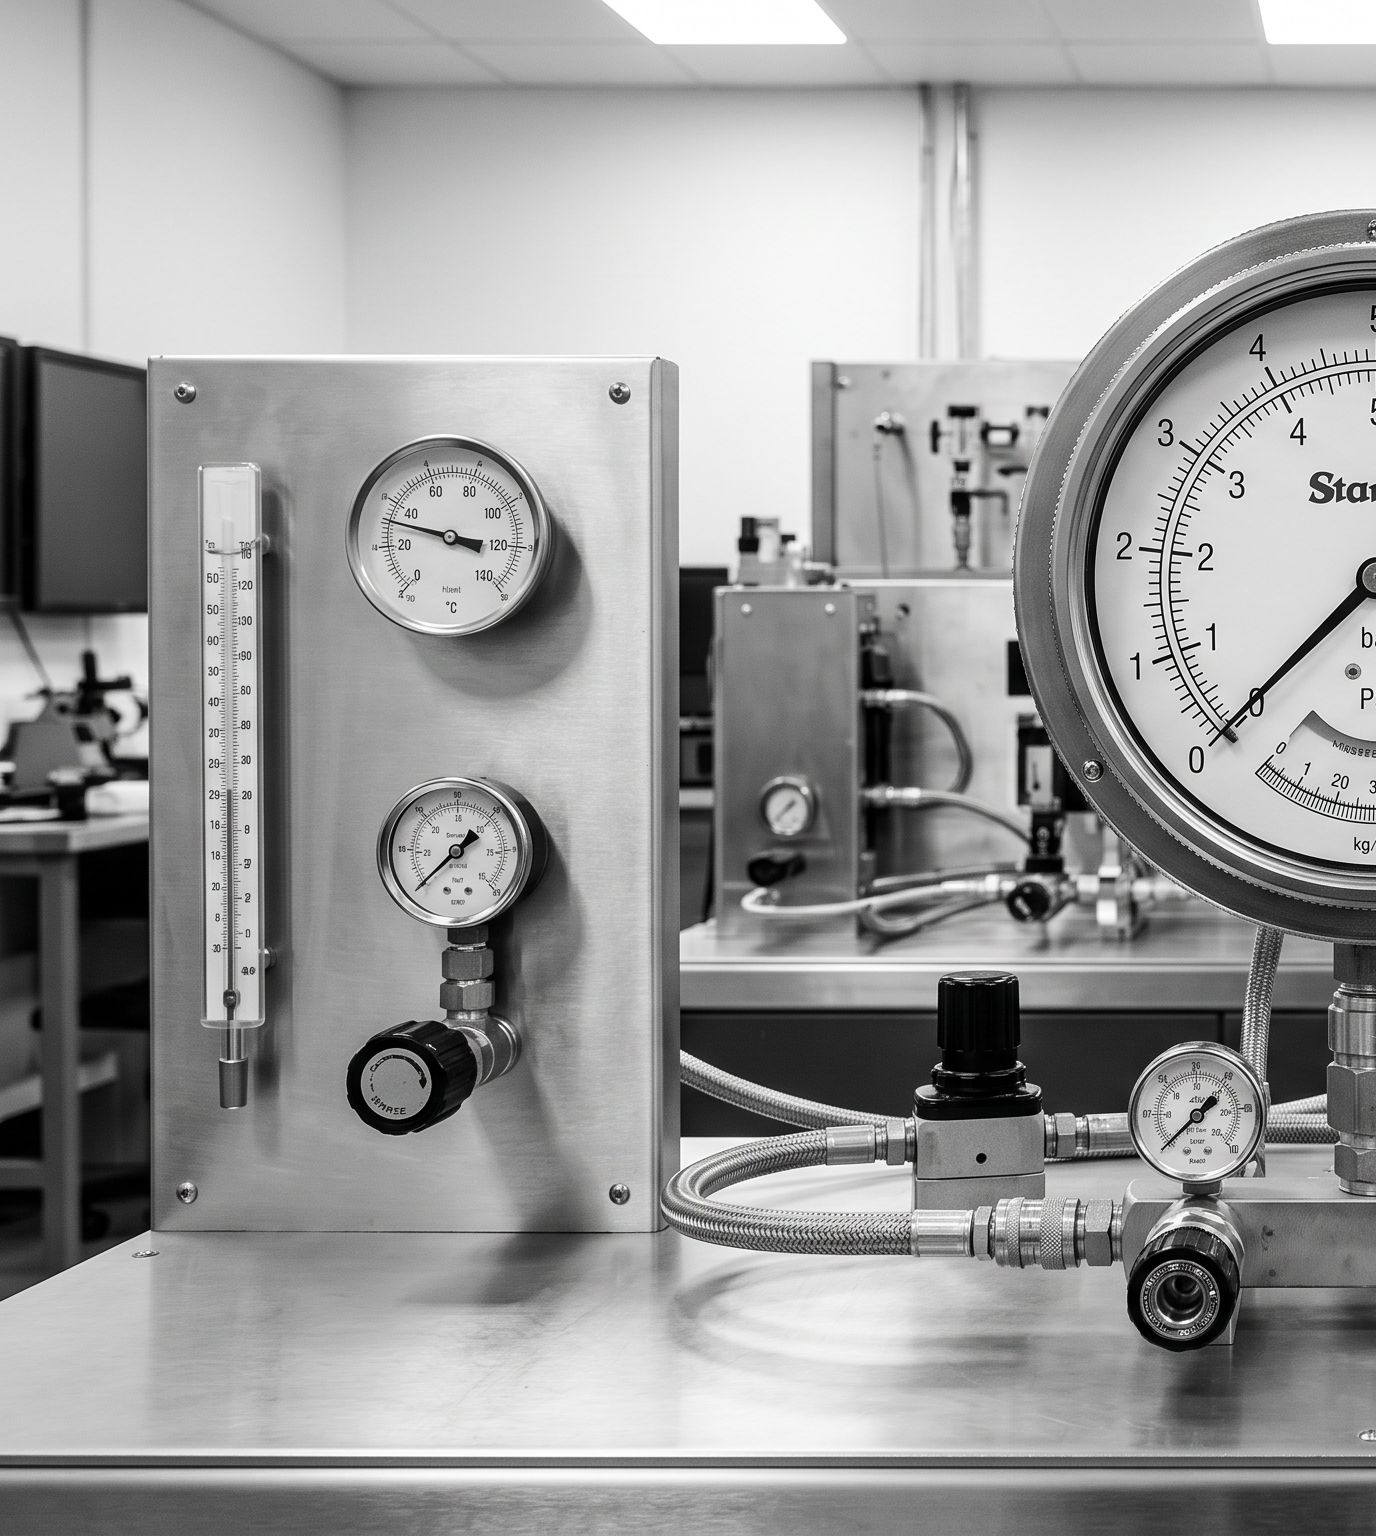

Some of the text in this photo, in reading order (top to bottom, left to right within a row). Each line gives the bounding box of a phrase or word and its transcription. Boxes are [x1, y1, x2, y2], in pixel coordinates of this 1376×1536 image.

[1249, 334, 1266, 361] 4
[1158, 419, 1173, 446] 3
[1290, 418, 1306, 445] 4
[1229, 471, 1244, 498] 3
[430, 486, 442, 497] 60
[463, 486, 475, 497] 80
[405, 508, 417, 519] 40
[485, 508, 501, 519] 100
[399, 539, 410, 550] 20
[490, 540, 507, 550] 120
[1117, 532, 1132, 559] 2
[1198, 543, 1213, 570] 2
[414, 570, 420, 581] 0
[238, 581, 253, 590] 120
[206, 605, 219, 615] 50
[446, 602, 456, 613] °C
[1206, 623, 1215, 650] 1
[208, 667, 219, 676] 30
[1130, 653, 1140, 680] 1
[208, 697, 219, 707] 40
[1276, 742, 1286, 754] 0
[1189, 746, 1204, 773] 0
[1331, 774, 1349, 789] 20
